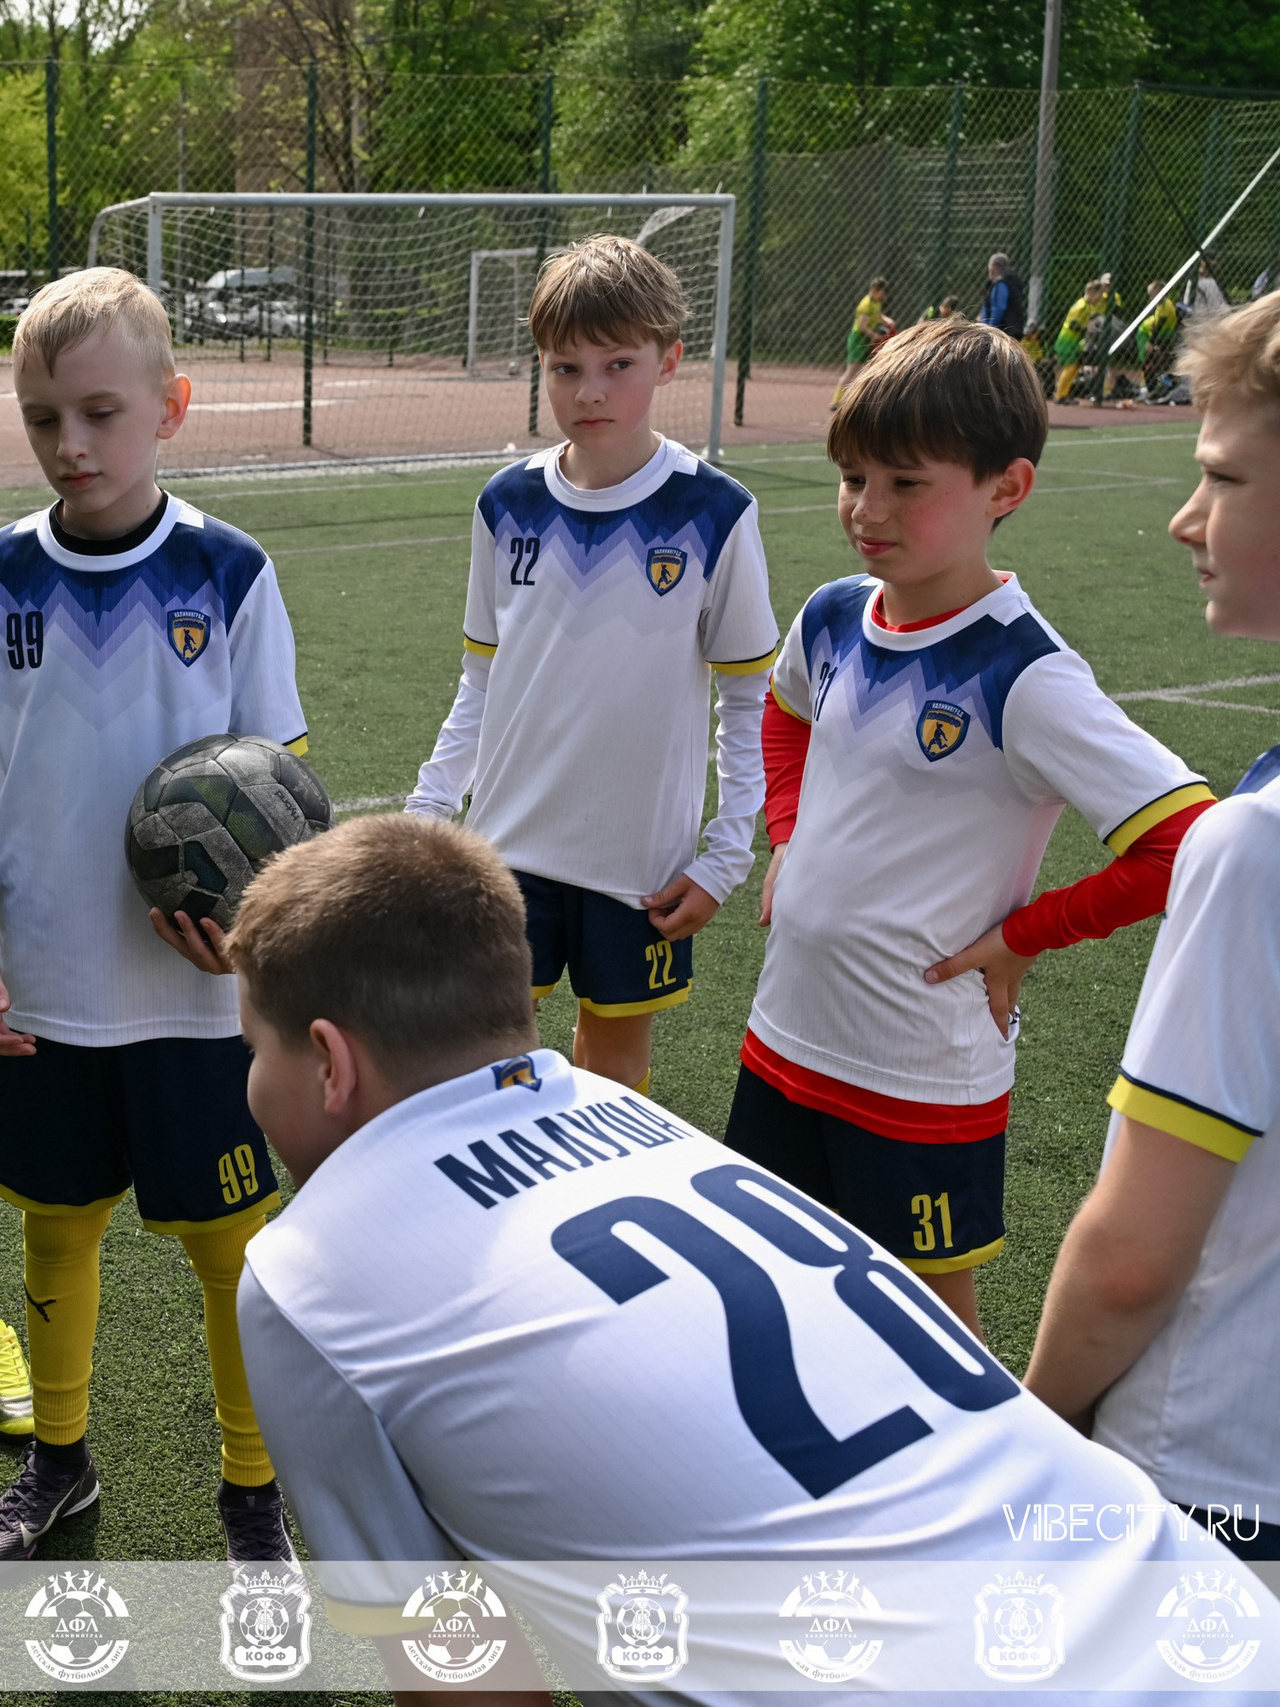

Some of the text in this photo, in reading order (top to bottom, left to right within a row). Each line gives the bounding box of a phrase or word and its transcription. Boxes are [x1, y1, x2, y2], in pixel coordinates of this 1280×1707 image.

[510, 537, 540, 586] 22
[6, 611, 44, 670] 99
[275, 790, 299, 821] Hybrid
[644, 939, 677, 990] 22
[218, 1143, 260, 1205] 99
[910, 1191, 954, 1252] 31
[549, 1163, 1022, 1501] 28
